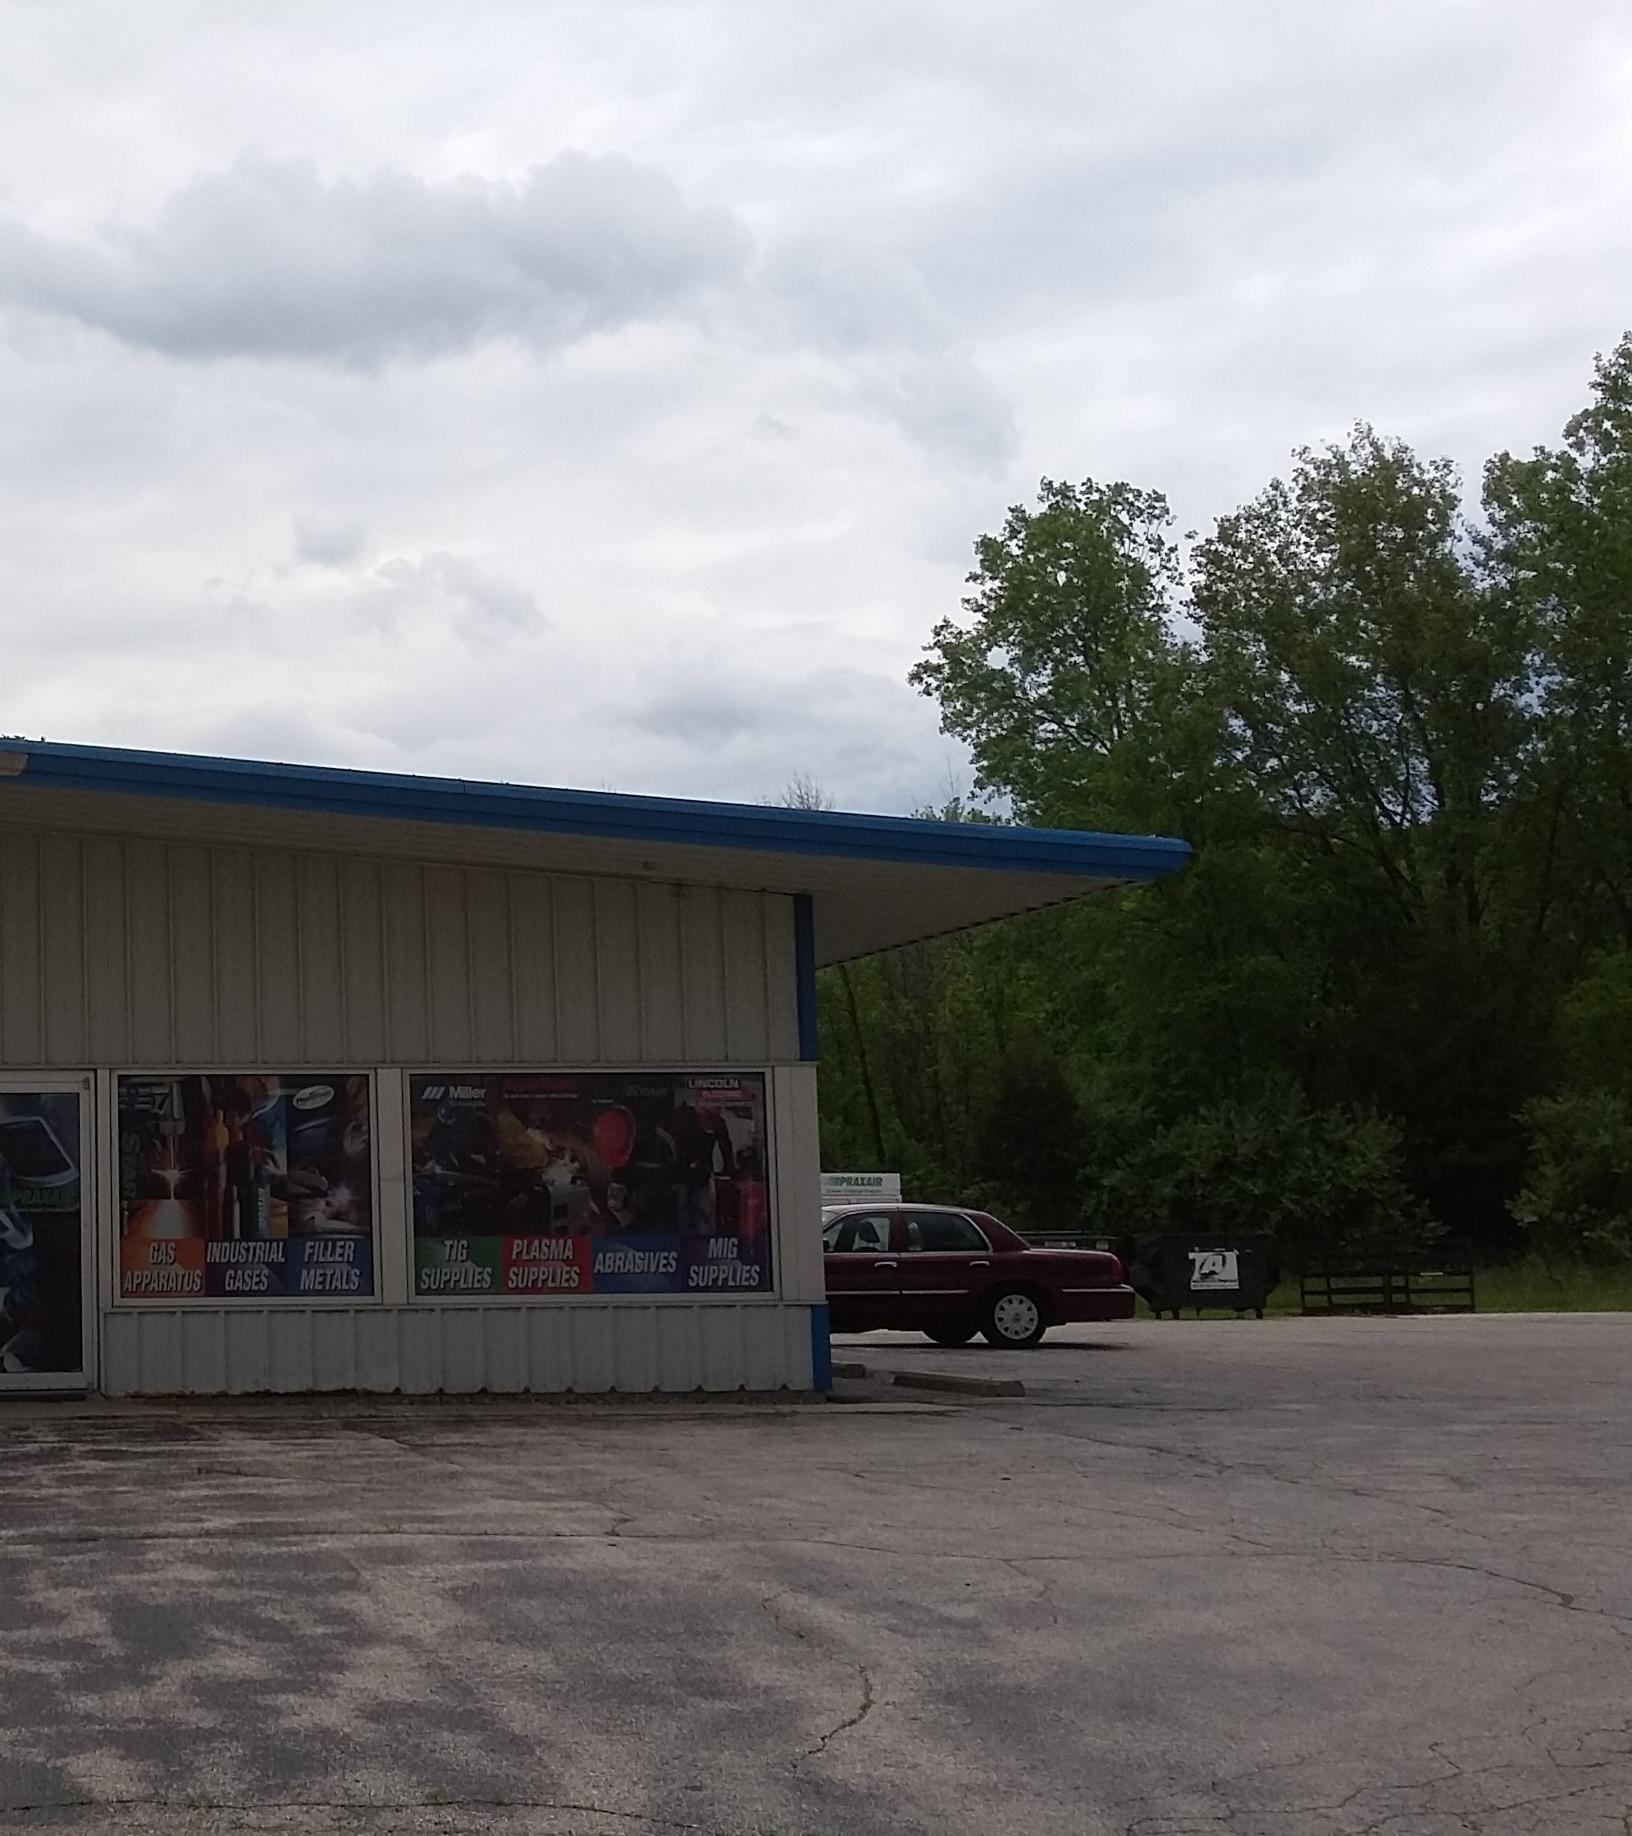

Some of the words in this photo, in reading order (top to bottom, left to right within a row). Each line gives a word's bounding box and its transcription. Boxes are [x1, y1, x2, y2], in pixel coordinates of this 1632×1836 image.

[449, 1085, 487, 1100] Miller
[687, 1078, 740, 1089] LINCOLN
[840, 1176, 883, 1187] PRAXAIR
[148, 1241, 176, 1265] GAS
[206, 1241, 286, 1264] INDUSTRIAL
[303, 1240, 355, 1264] FILLER
[443, 1239, 469, 1263] TIG
[511, 1238, 575, 1261] PLASMA
[707, 1236, 738, 1259] MIG
[593, 1251, 678, 1275] ABRASIVES
[123, 1270, 202, 1292] APPARATUS
[224, 1268, 269, 1291] GASES
[299, 1268, 360, 1291] METALS
[420, 1266, 492, 1290] SUPPLIES
[507, 1266, 580, 1289] SUPPLIES
[687, 1264, 760, 1288] SUPPLIES
